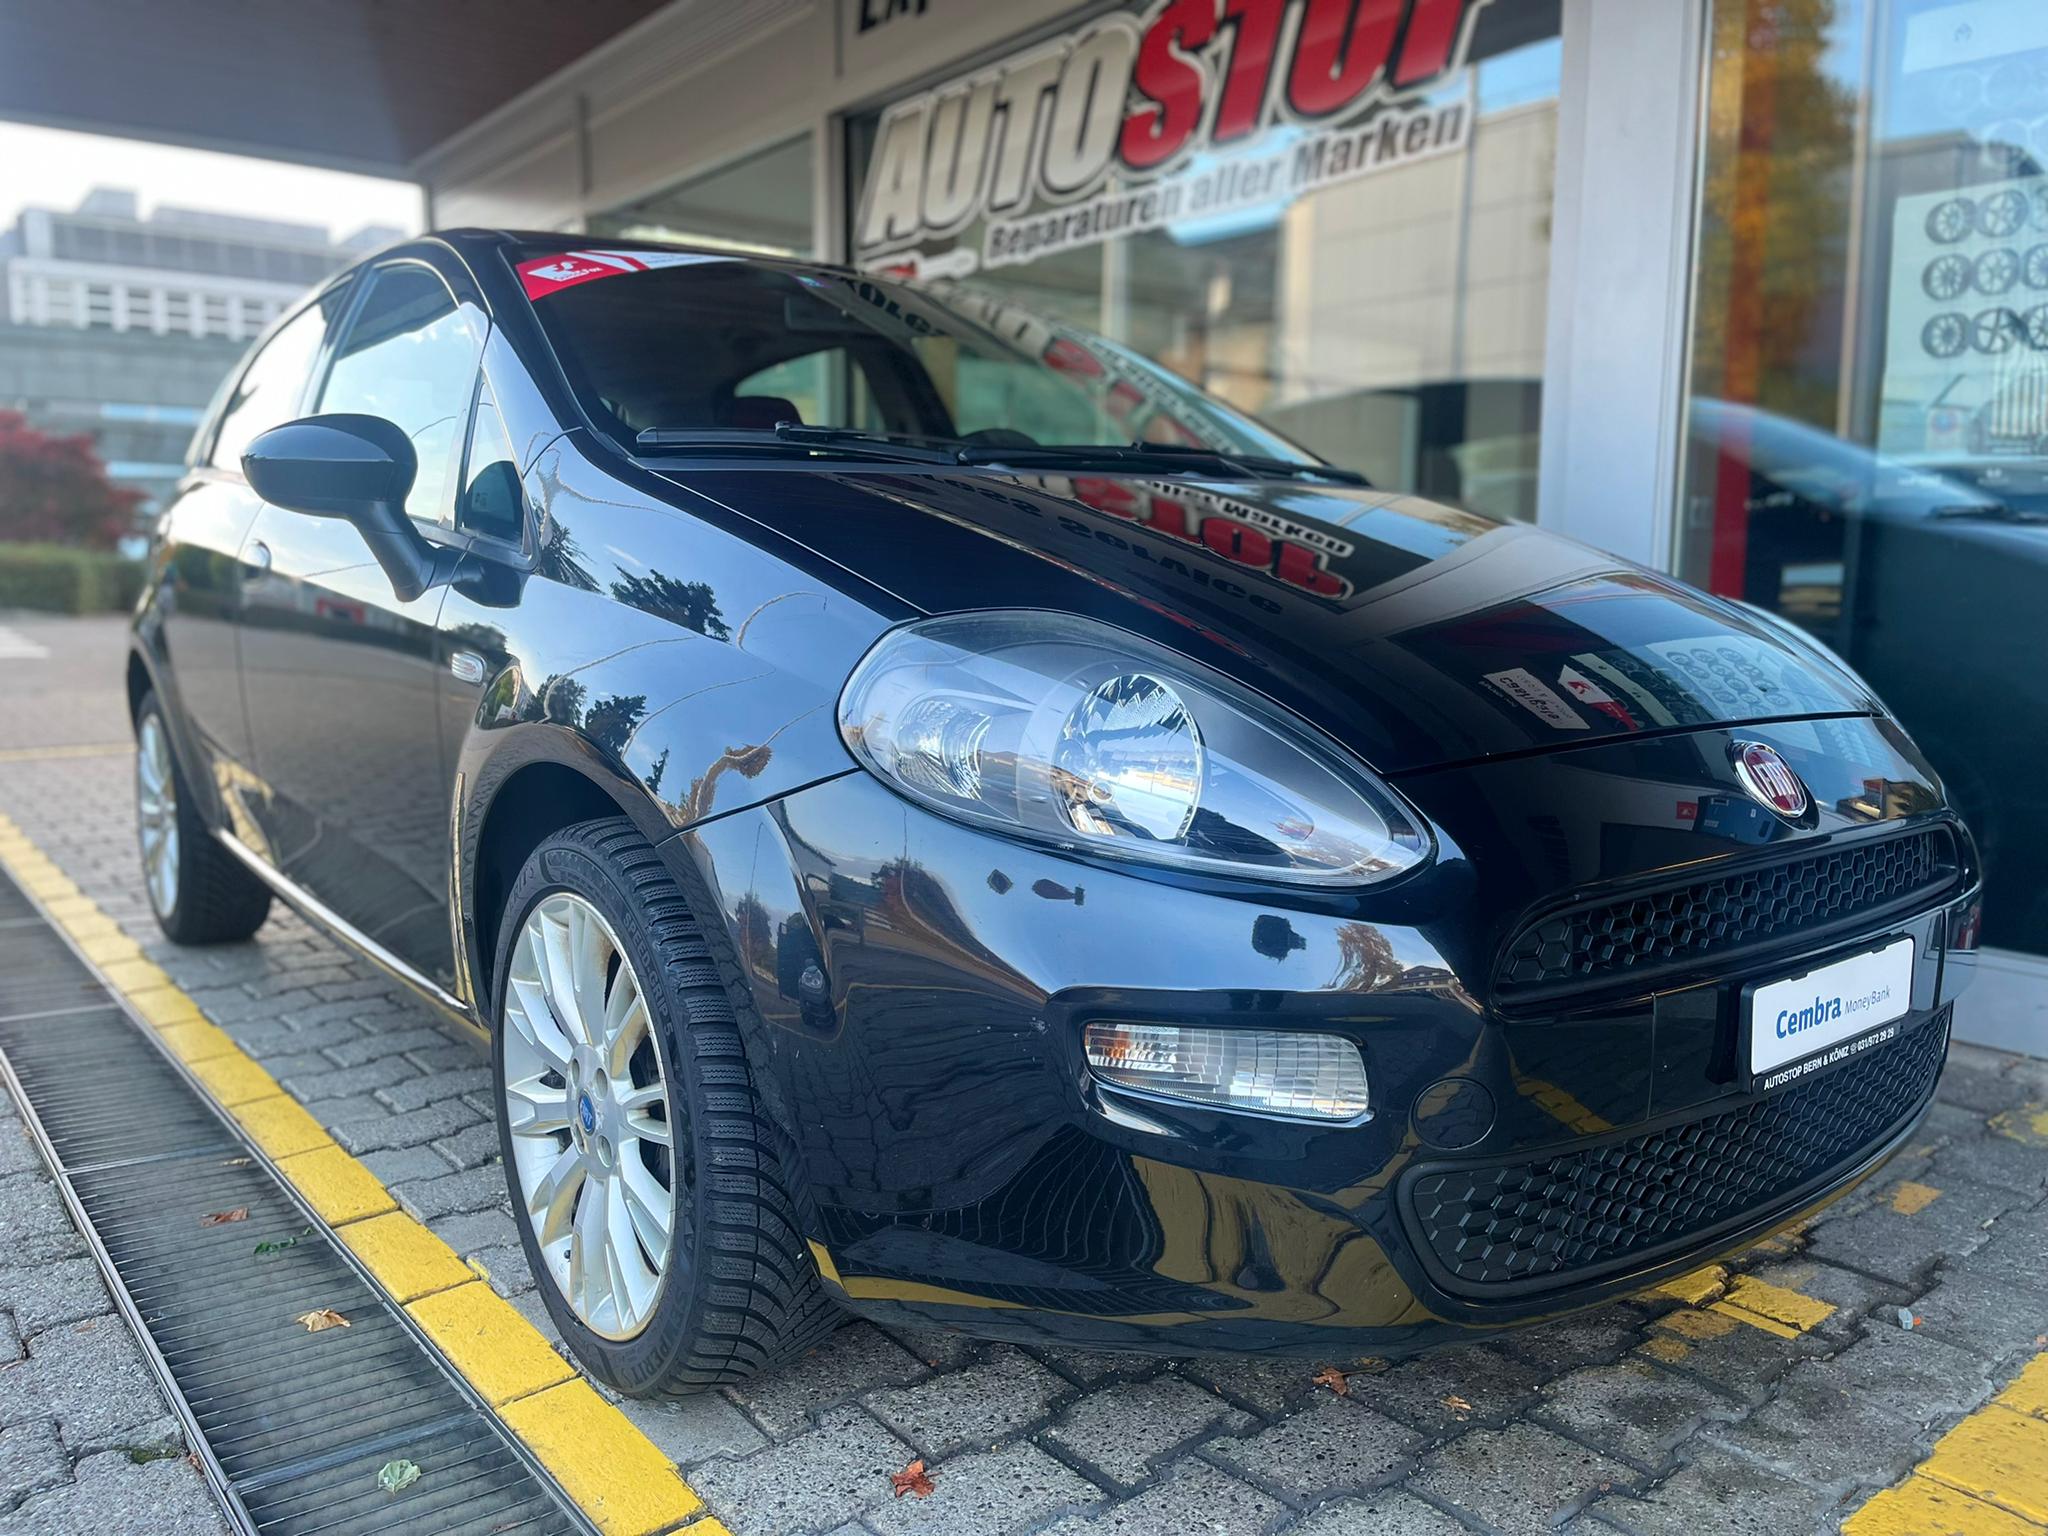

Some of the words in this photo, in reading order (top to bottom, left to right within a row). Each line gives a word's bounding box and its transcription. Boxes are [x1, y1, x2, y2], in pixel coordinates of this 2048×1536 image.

[991, 178, 1182, 259] Reparaturen
[1188, 158, 1281, 208] aller
[1291, 103, 1467, 192] Marken
[1752, 760, 1796, 799] FIAT
[622, 911, 669, 1018] SPEED-GRIP
[663, 1022, 674, 1037] 5
[1776, 996, 1842, 1039] Cembra
[1844, 985, 1891, 1015] MoneyBank
[1763, 1065, 1803, 1091] AUTOSTOP
[1803, 1057, 1822, 1075] BERN
[1823, 1055, 1829, 1066] &
[1829, 1045, 1850, 1063] KÖNIZ
[1880, 1030, 1887, 1042] 29
[1887, 1027, 1895, 1038] 29
